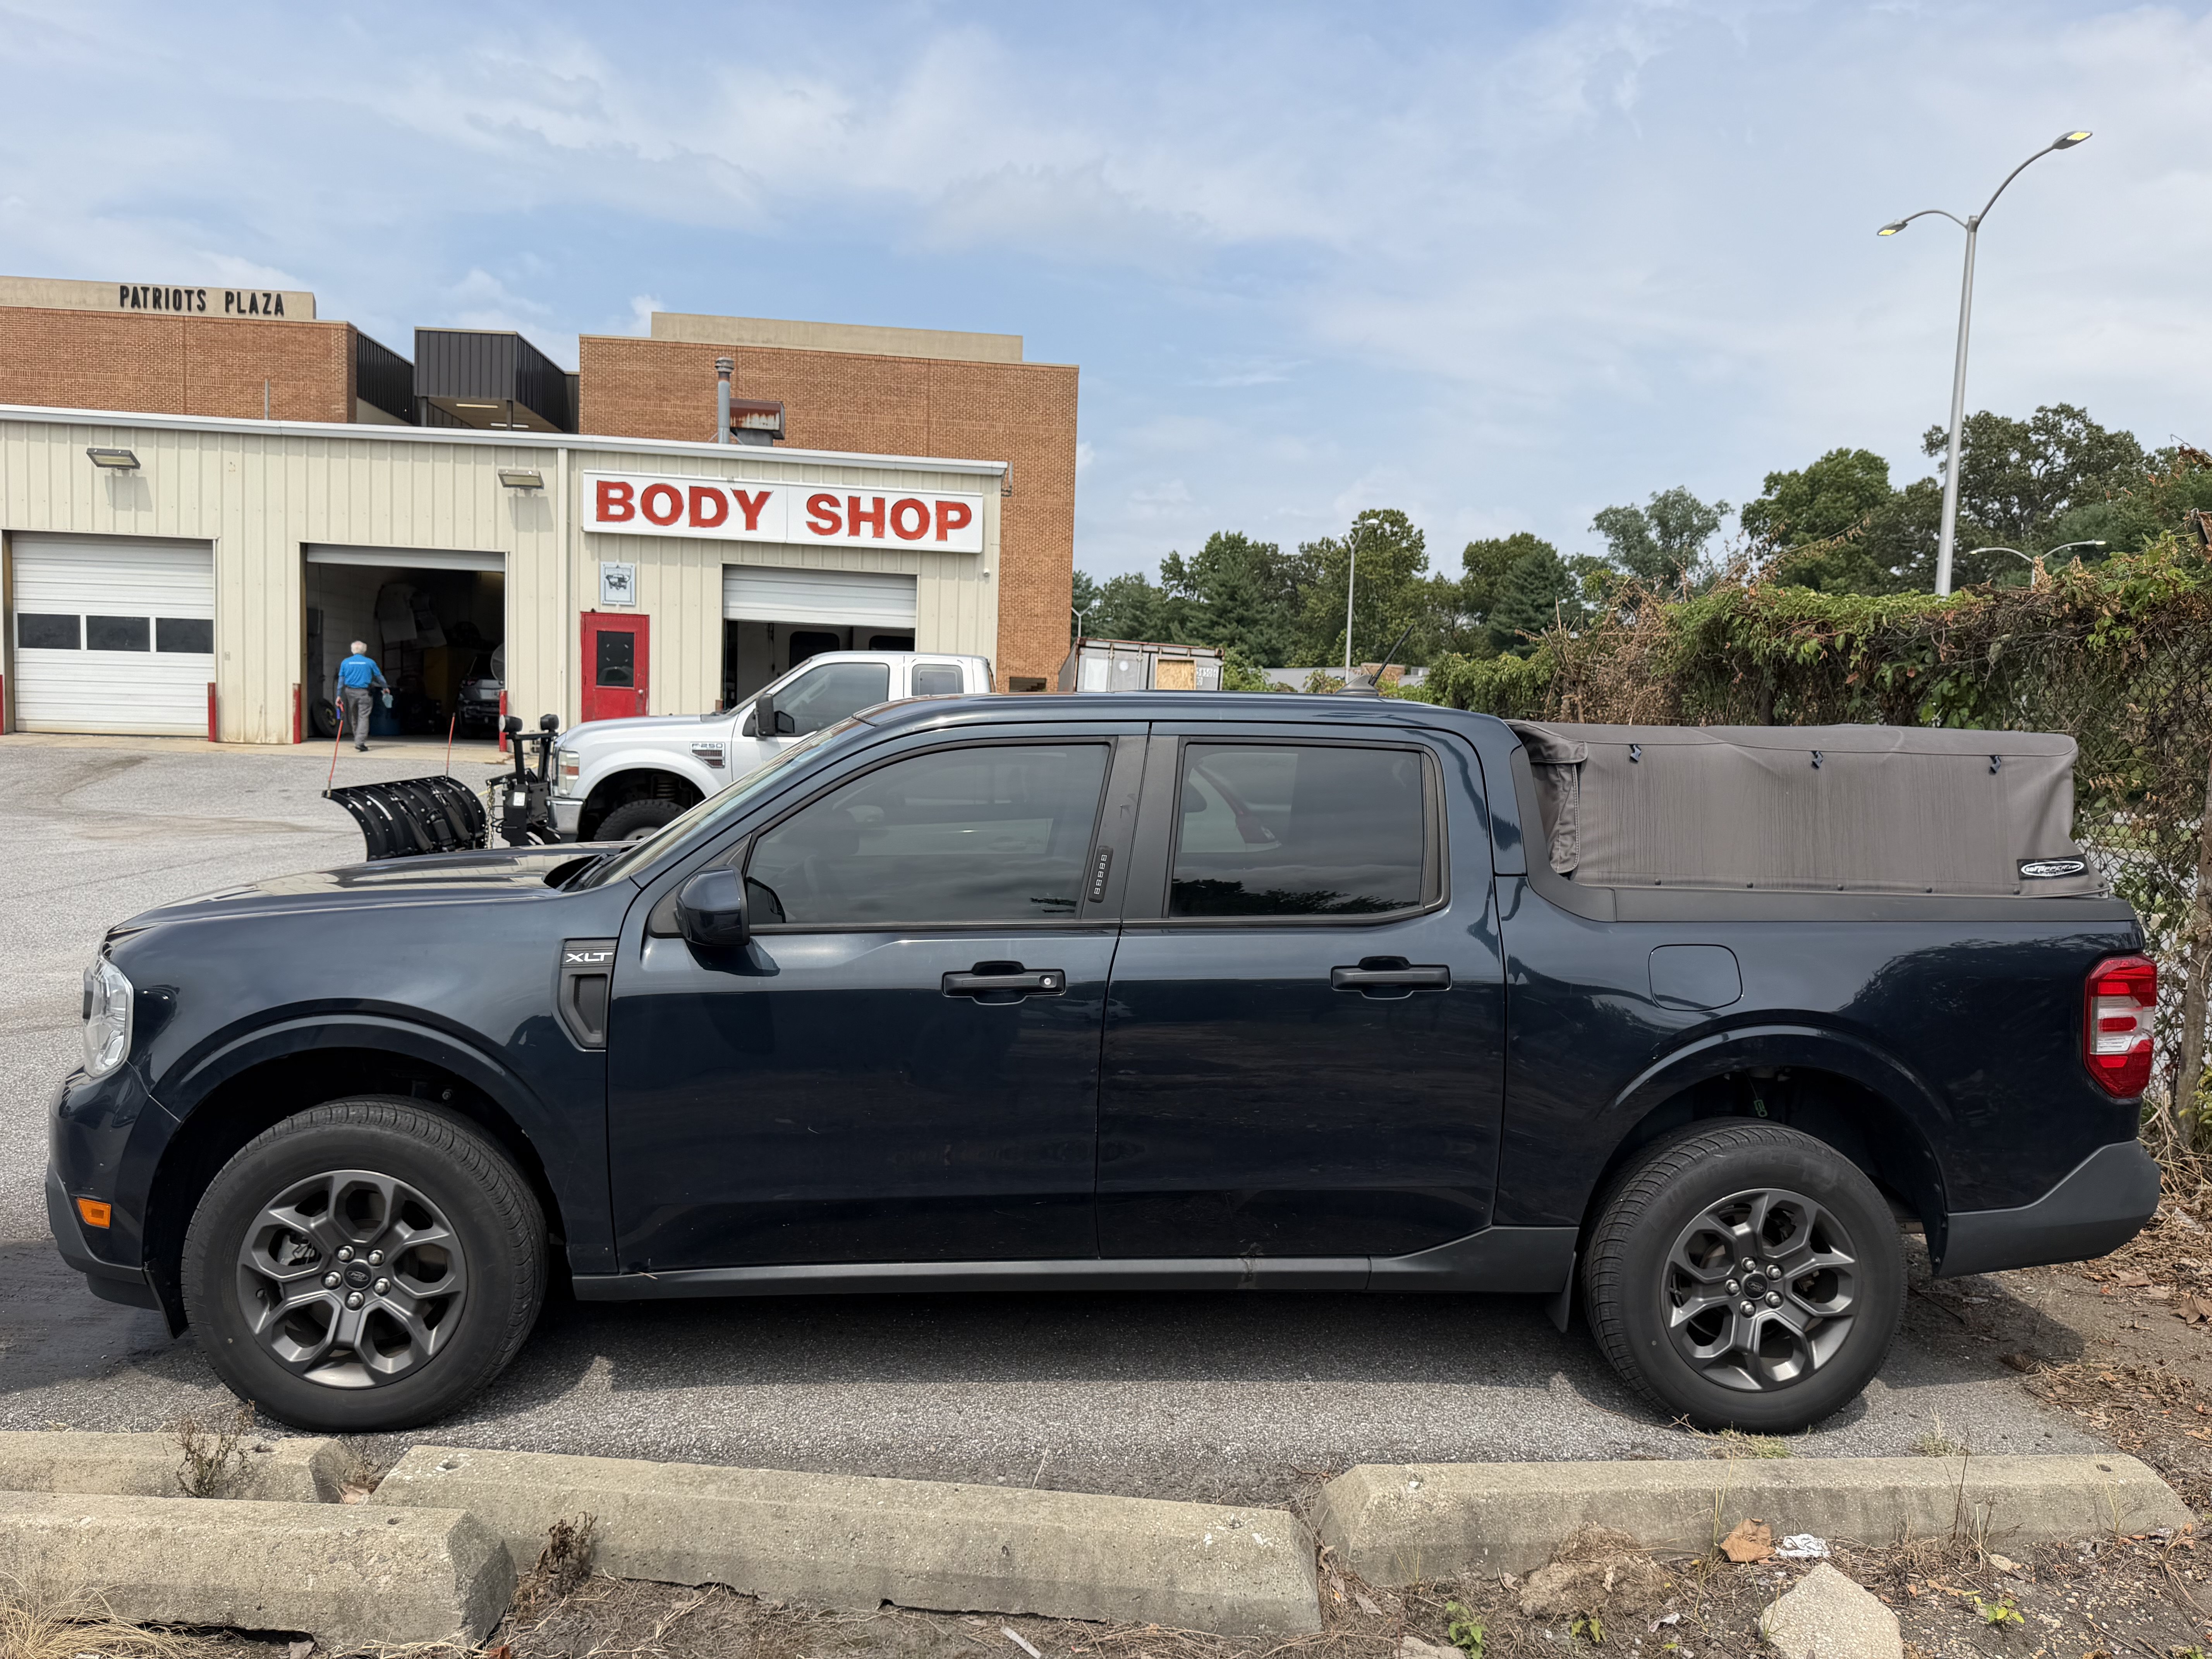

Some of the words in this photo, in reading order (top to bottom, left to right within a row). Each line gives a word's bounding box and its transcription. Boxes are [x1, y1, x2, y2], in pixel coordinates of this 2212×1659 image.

[120, 285, 206, 312] PATRIOTS
[225, 291, 285, 316] PLAZA
[596, 480, 773, 531] BODY
[805, 493, 972, 541] SHOP
[565, 952, 613, 963] XLT
